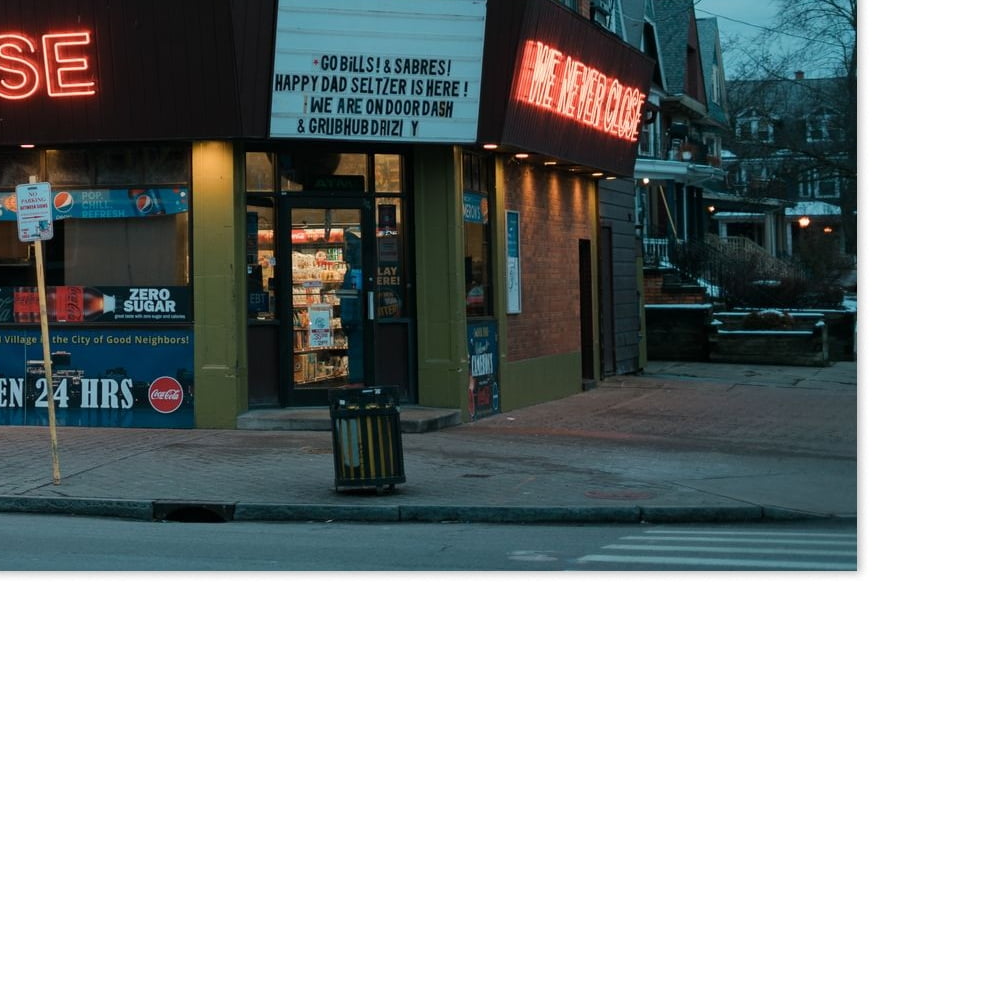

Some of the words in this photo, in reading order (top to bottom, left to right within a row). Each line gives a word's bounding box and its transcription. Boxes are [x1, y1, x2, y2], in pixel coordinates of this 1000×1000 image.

[321, 55, 337, 71] GO
[384, 59, 391, 73] &
[275, 74, 319, 92] HAPPY
[322, 75, 347, 92] DAD
[351, 76, 406, 95] SELTZER
[411, 80, 423, 95] IS
[527, 41, 562, 107] WE
[557, 55, 607, 127] NEVER
[604, 78, 646, 141] CLOSE
[311, 97, 333, 113] WE
[337, 98, 361, 114] ARE
[366, 99, 383, 115] ON
[297, 118, 305, 133] &
[308, 117, 369, 136] GRUBHUB
[377, 267, 398, 276] LAY
[376, 276, 400, 286] ERE!
[129, 288, 170, 300] ZERO
[123, 300, 176, 312] SUGAR
[4, 335, 37, 345] Village
[52, 335, 68, 344] the
[71, 335, 90, 345] City
[94, 335, 103, 344] of
[106, 335, 131, 344] Good
[135, 335, 189, 346] Neighbors!
[34, 378, 69, 408] 24
[80, 378, 134, 409] HRS
